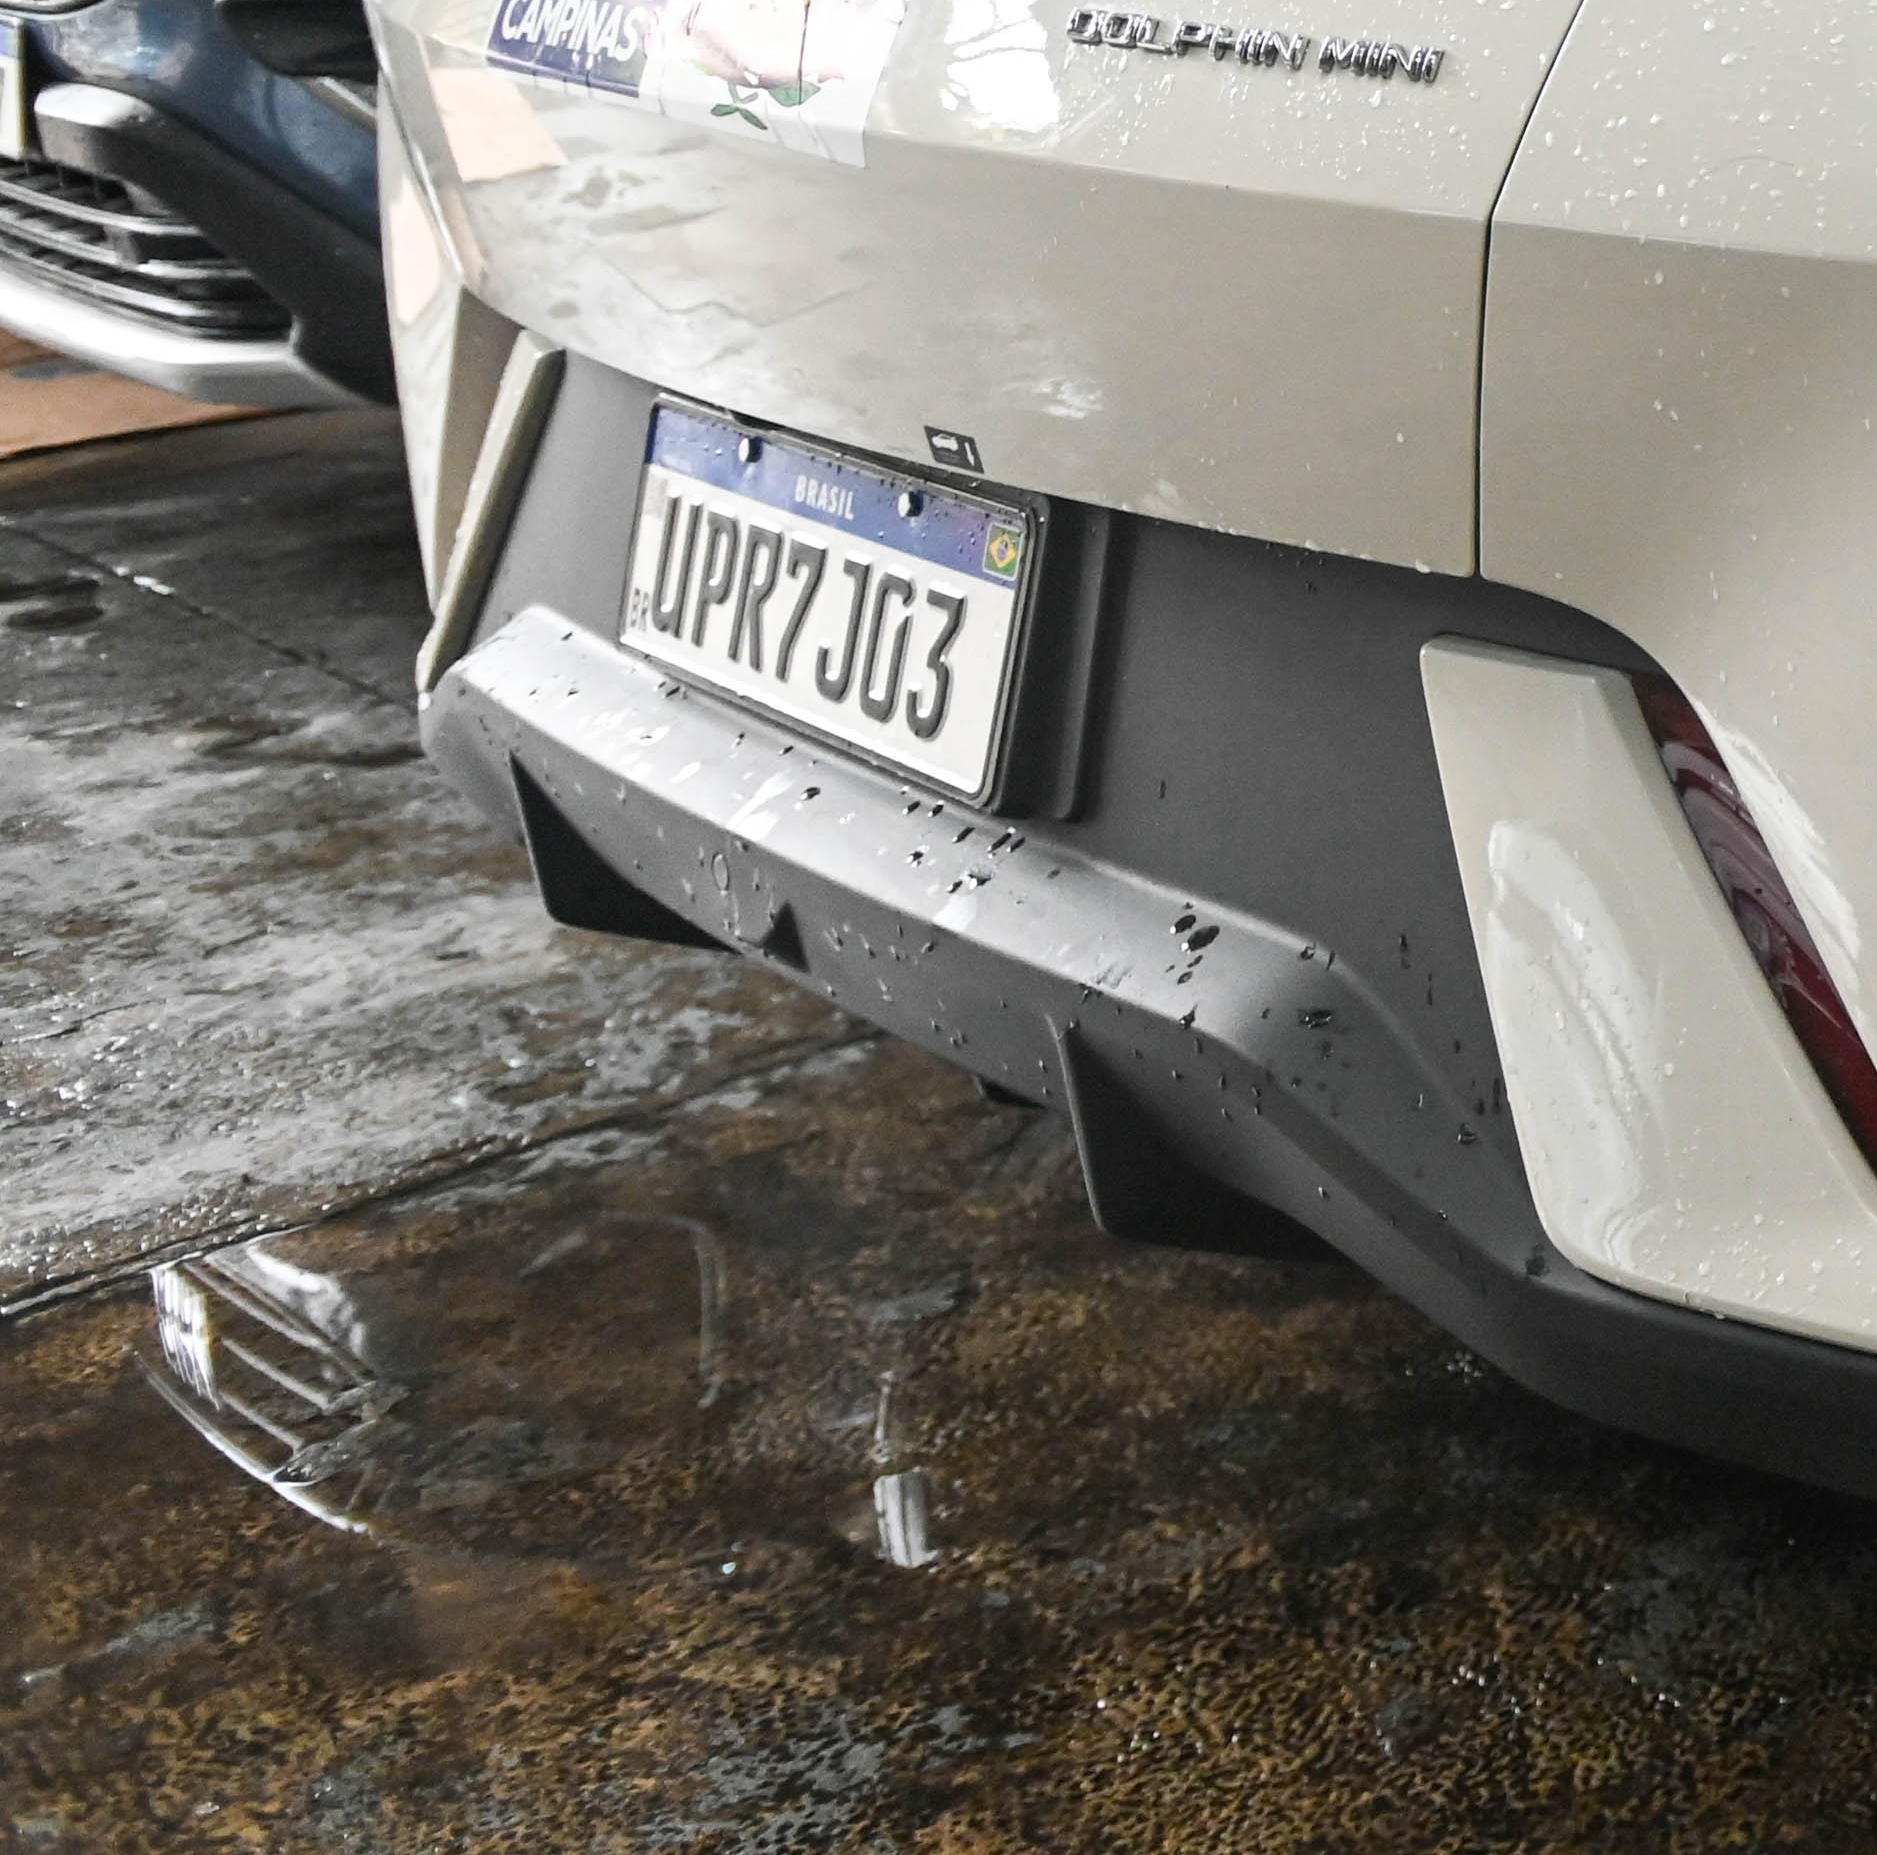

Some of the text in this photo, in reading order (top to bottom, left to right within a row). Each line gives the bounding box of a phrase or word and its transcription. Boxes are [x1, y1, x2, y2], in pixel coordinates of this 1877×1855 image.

[1065, 7, 1446, 84] DOLPHIN MINI
[794, 474, 856, 522] BRASIL
[651, 489, 967, 742] UPR7J03
